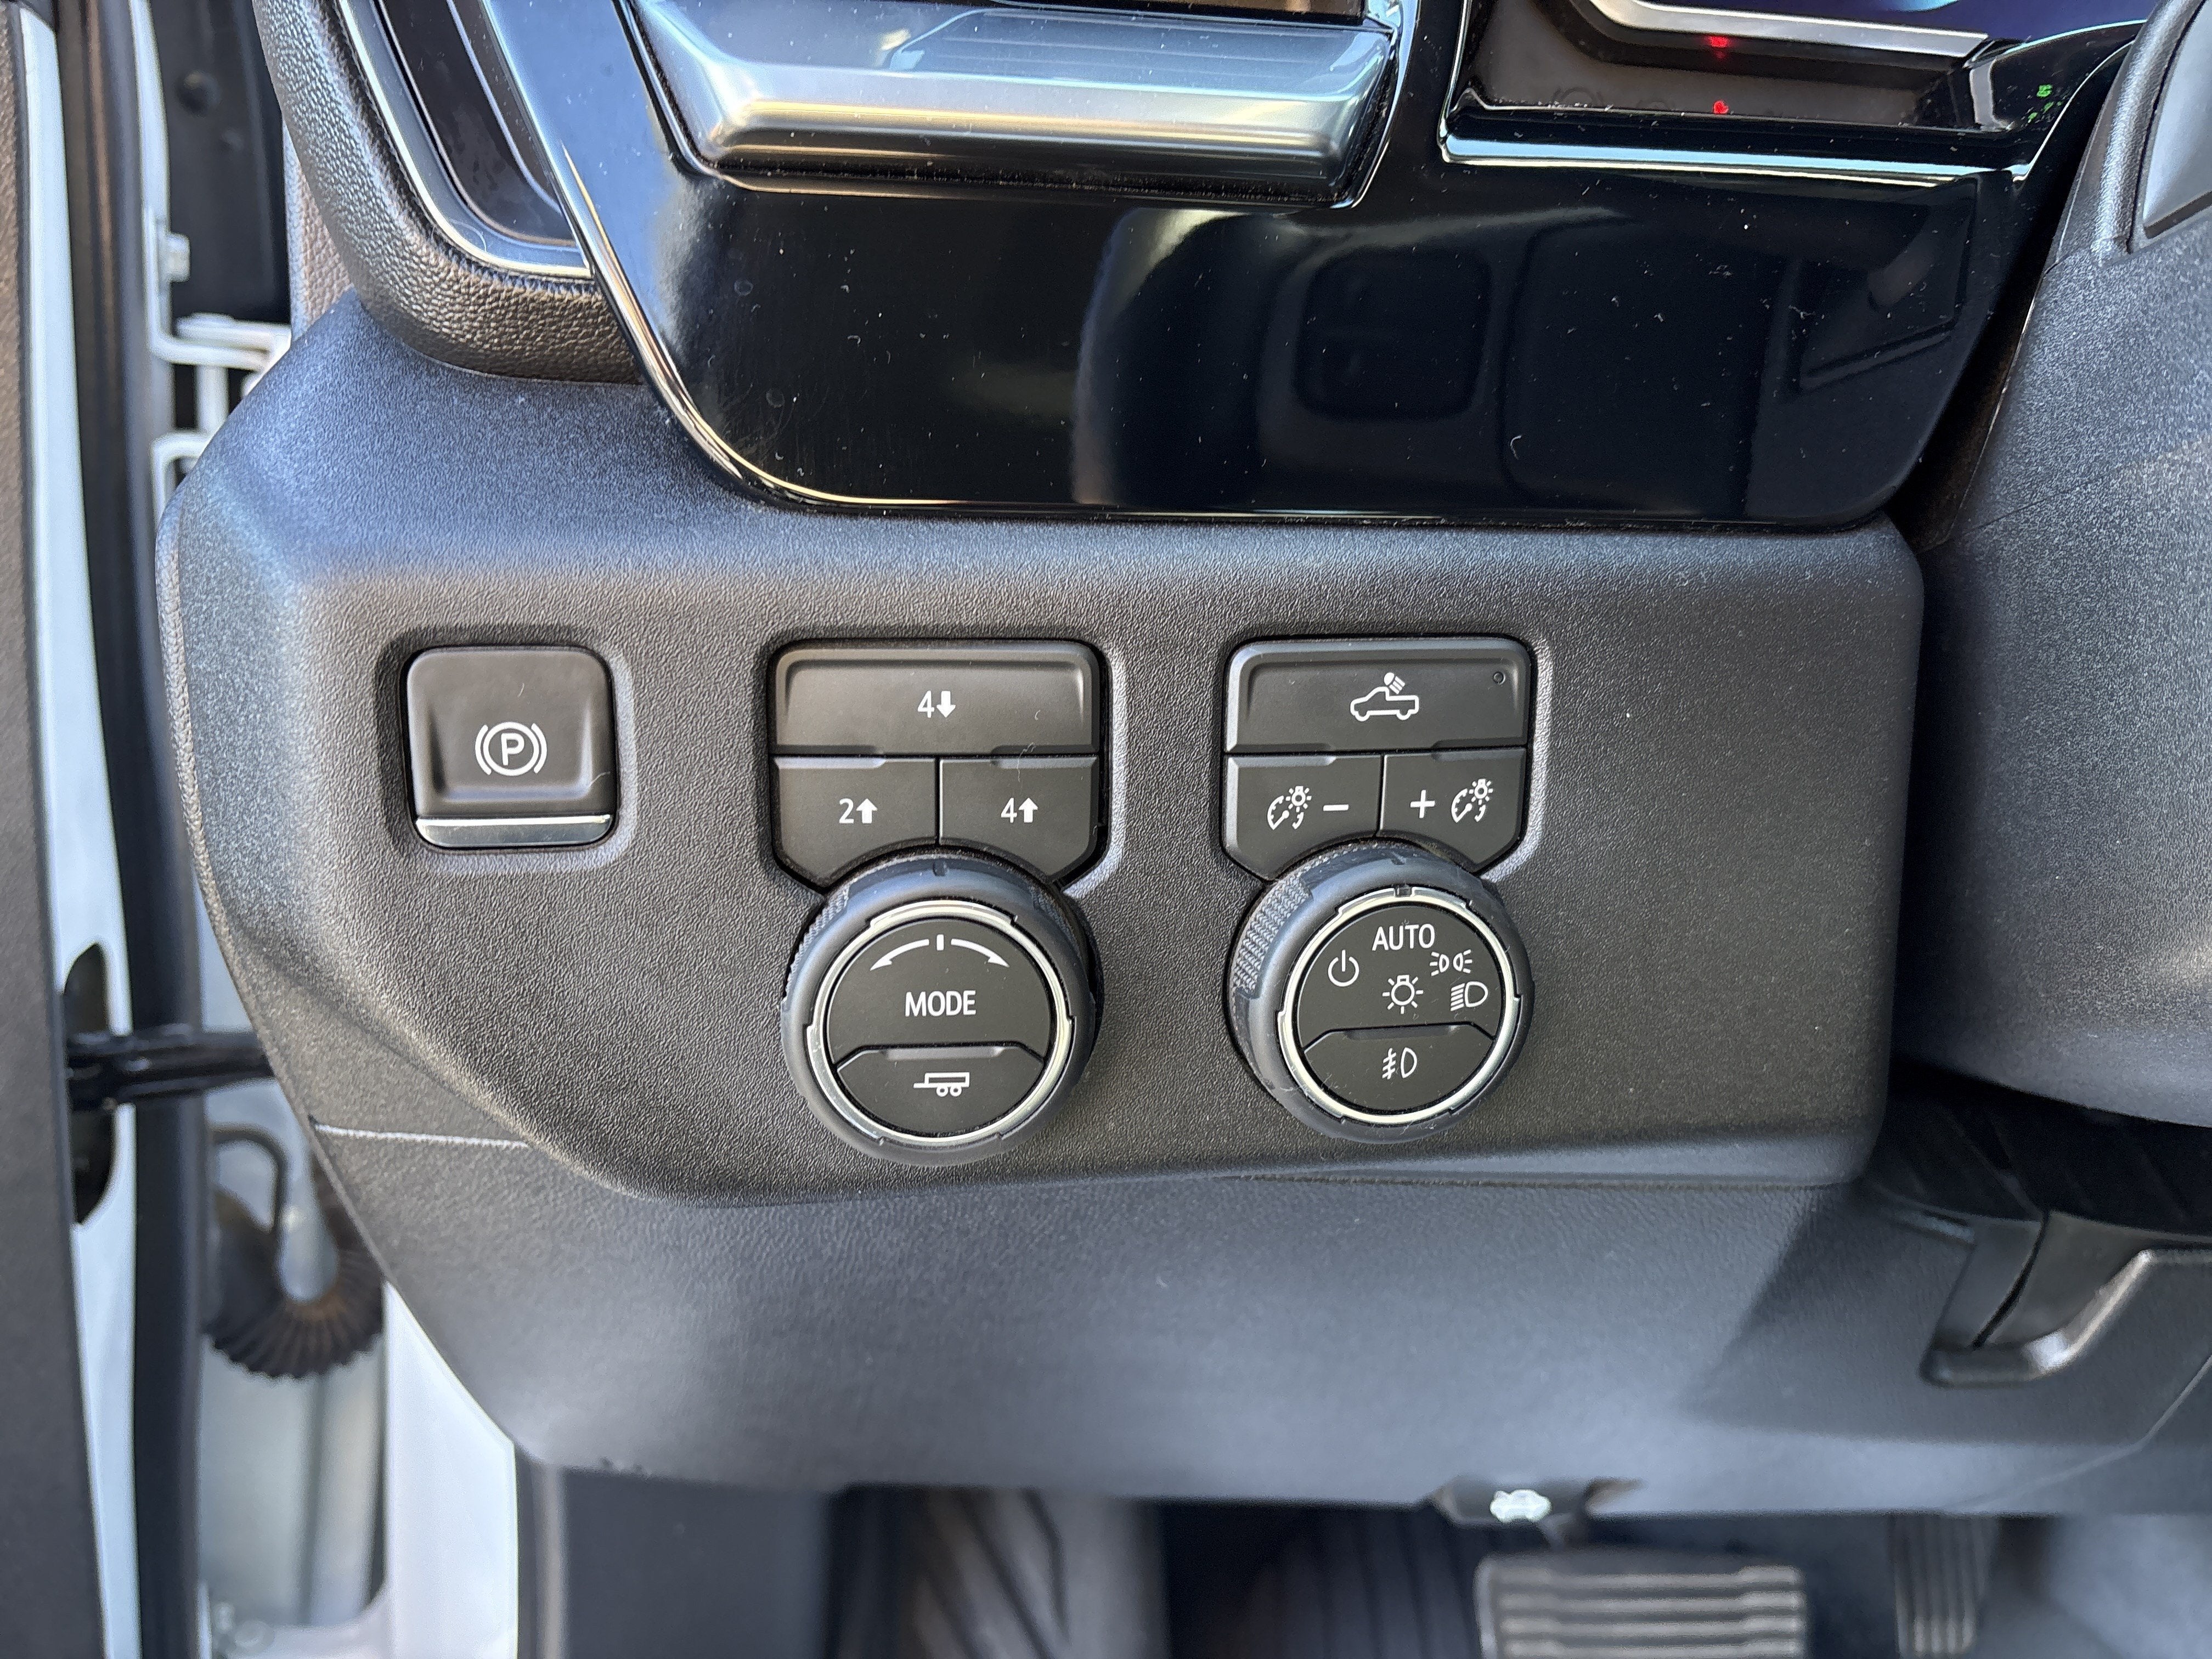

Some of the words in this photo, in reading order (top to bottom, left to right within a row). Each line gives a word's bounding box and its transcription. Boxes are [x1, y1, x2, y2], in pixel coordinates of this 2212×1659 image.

[917, 690, 935, 719] 4
[500, 732, 524, 766] P
[838, 797, 855, 825] 2
[1000, 797, 1018, 824] 4
[1372, 923, 1436, 951] AUTO
[904, 990, 977, 1017] MODE
